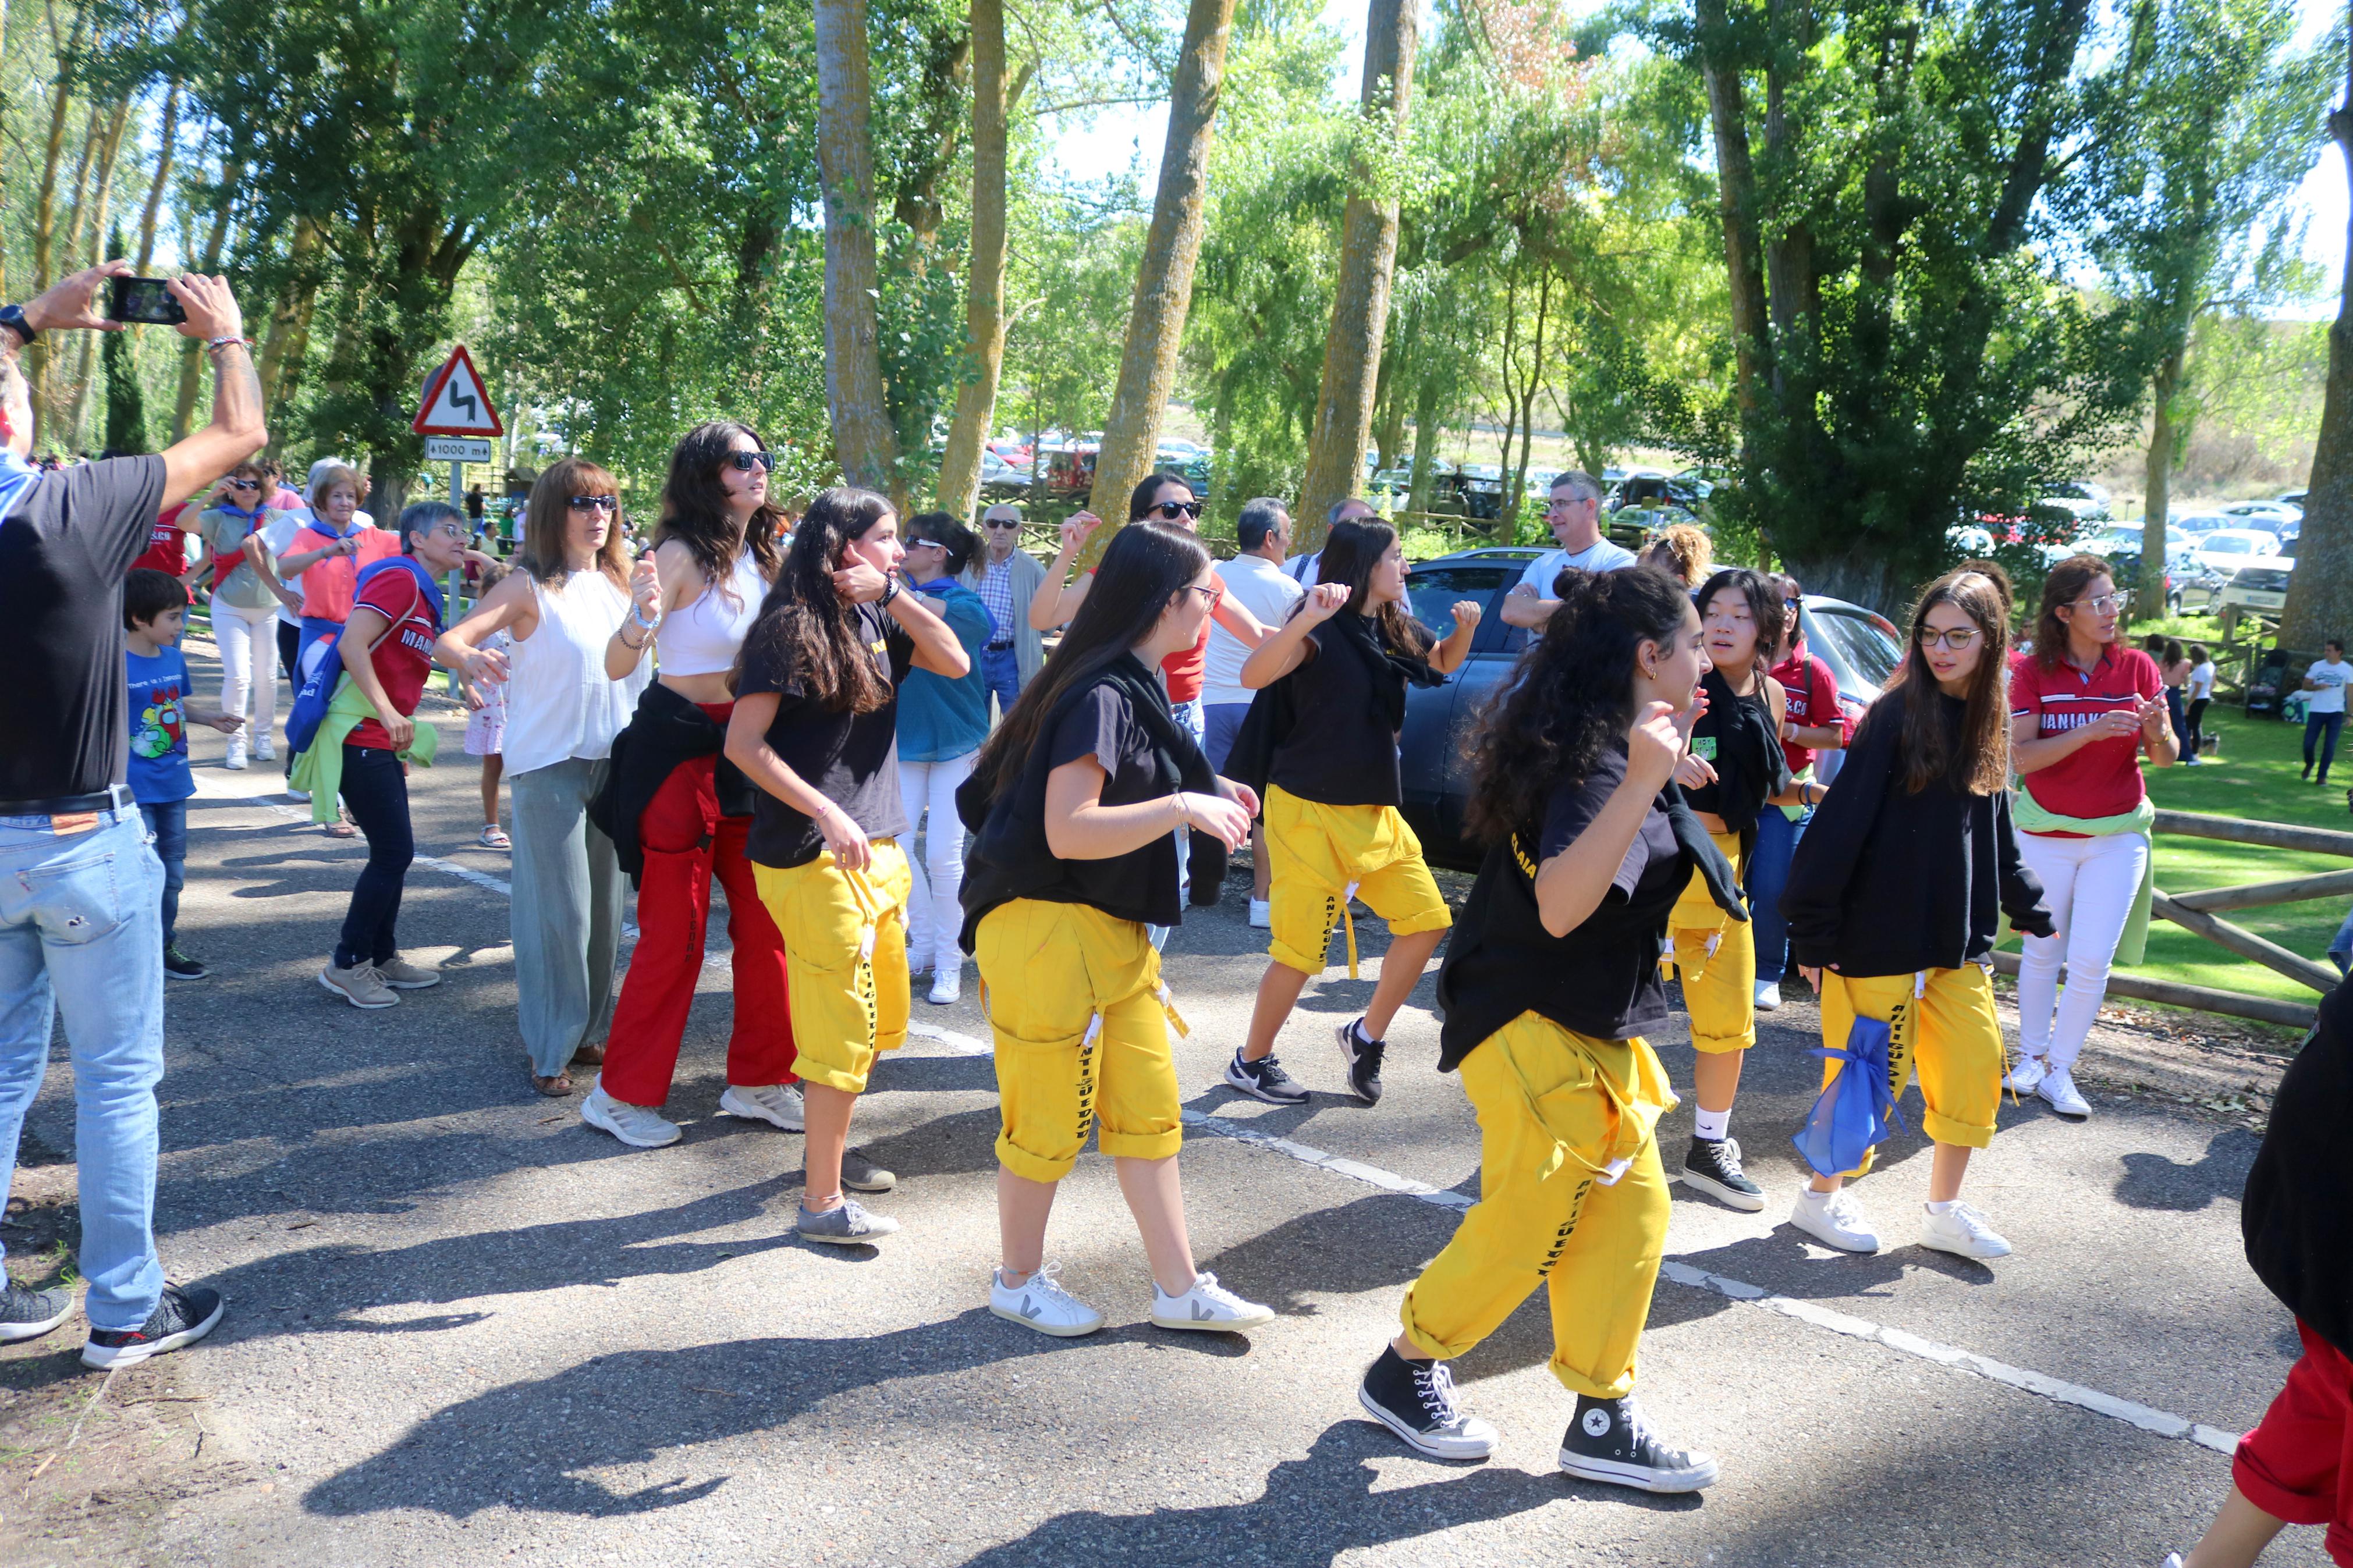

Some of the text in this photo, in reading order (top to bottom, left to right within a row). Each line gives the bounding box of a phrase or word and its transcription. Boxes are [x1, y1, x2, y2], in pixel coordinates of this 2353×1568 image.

[438, 445, 465, 454] 1000
[2041, 713, 2107, 729] ANIAK
[1076, 1044, 1093, 1139] NTIGÜEDAD
